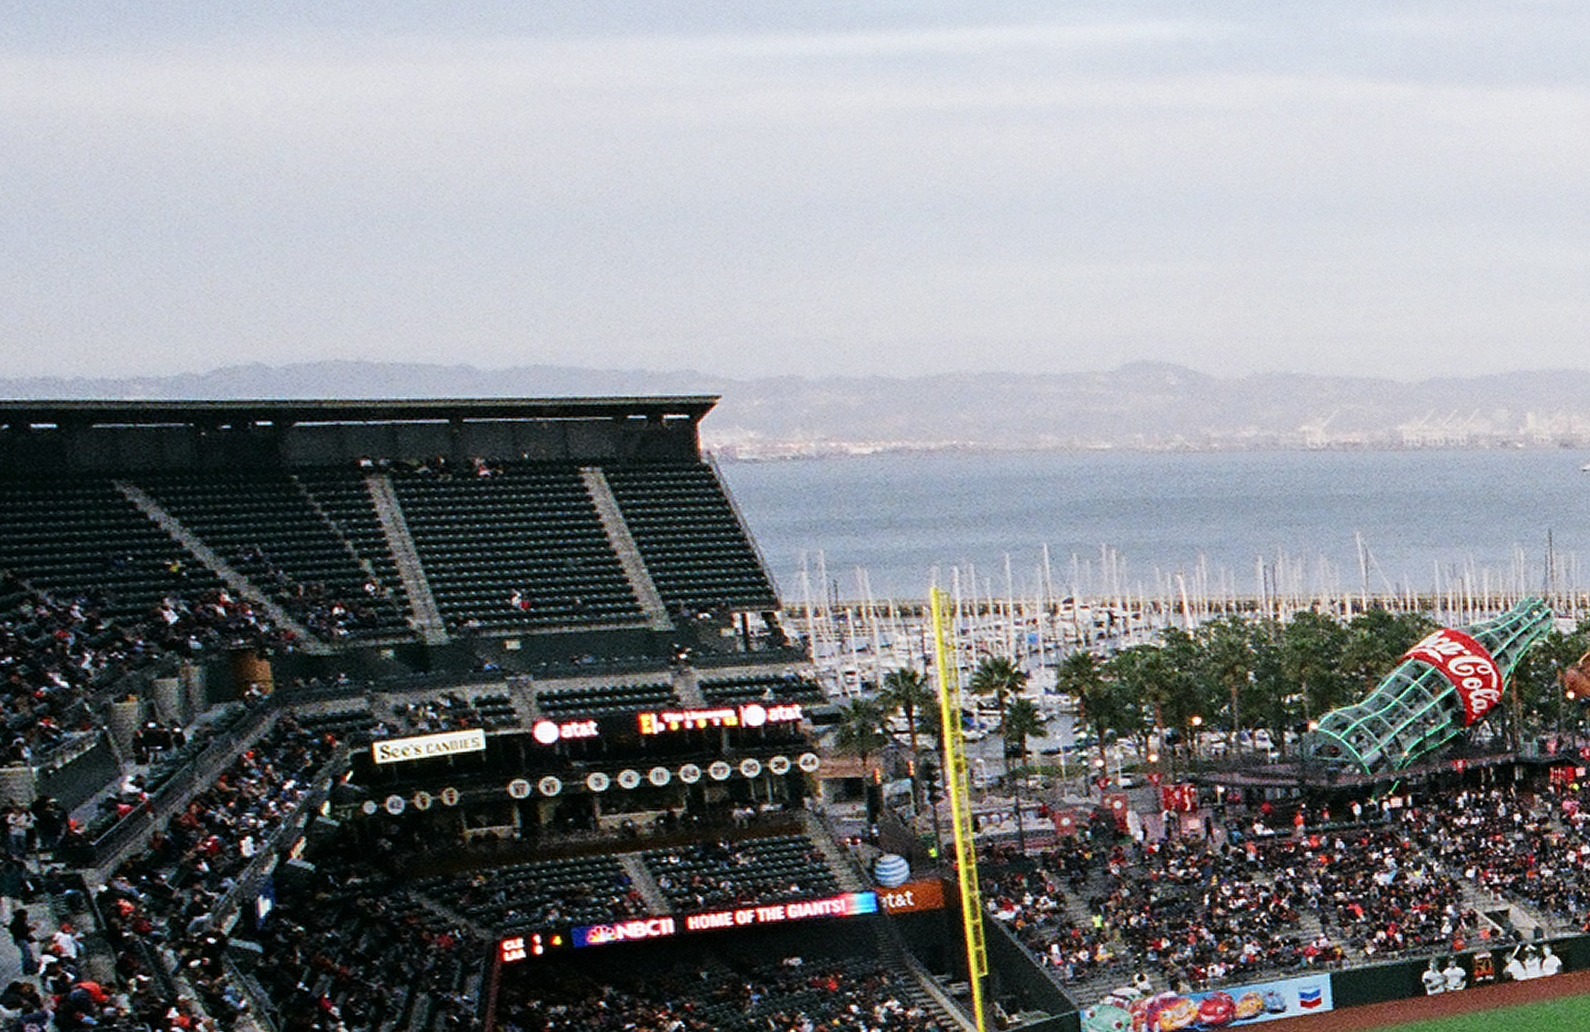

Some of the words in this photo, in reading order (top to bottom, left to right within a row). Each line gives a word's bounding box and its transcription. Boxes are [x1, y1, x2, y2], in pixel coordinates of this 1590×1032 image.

[1404, 628, 1501, 715] Coca-Cola
[766, 704, 803, 722] at&t
[559, 720, 600, 739] at&t
[380, 743, 424, 761] See's
[426, 737, 482, 755] CANDIES
[687, 912, 734, 931] HOME
[735, 909, 756, 926] OF
[757, 905, 786, 922] THE
[787, 899, 846, 919] GIANTS!
[613, 917, 677, 940] NBC11
